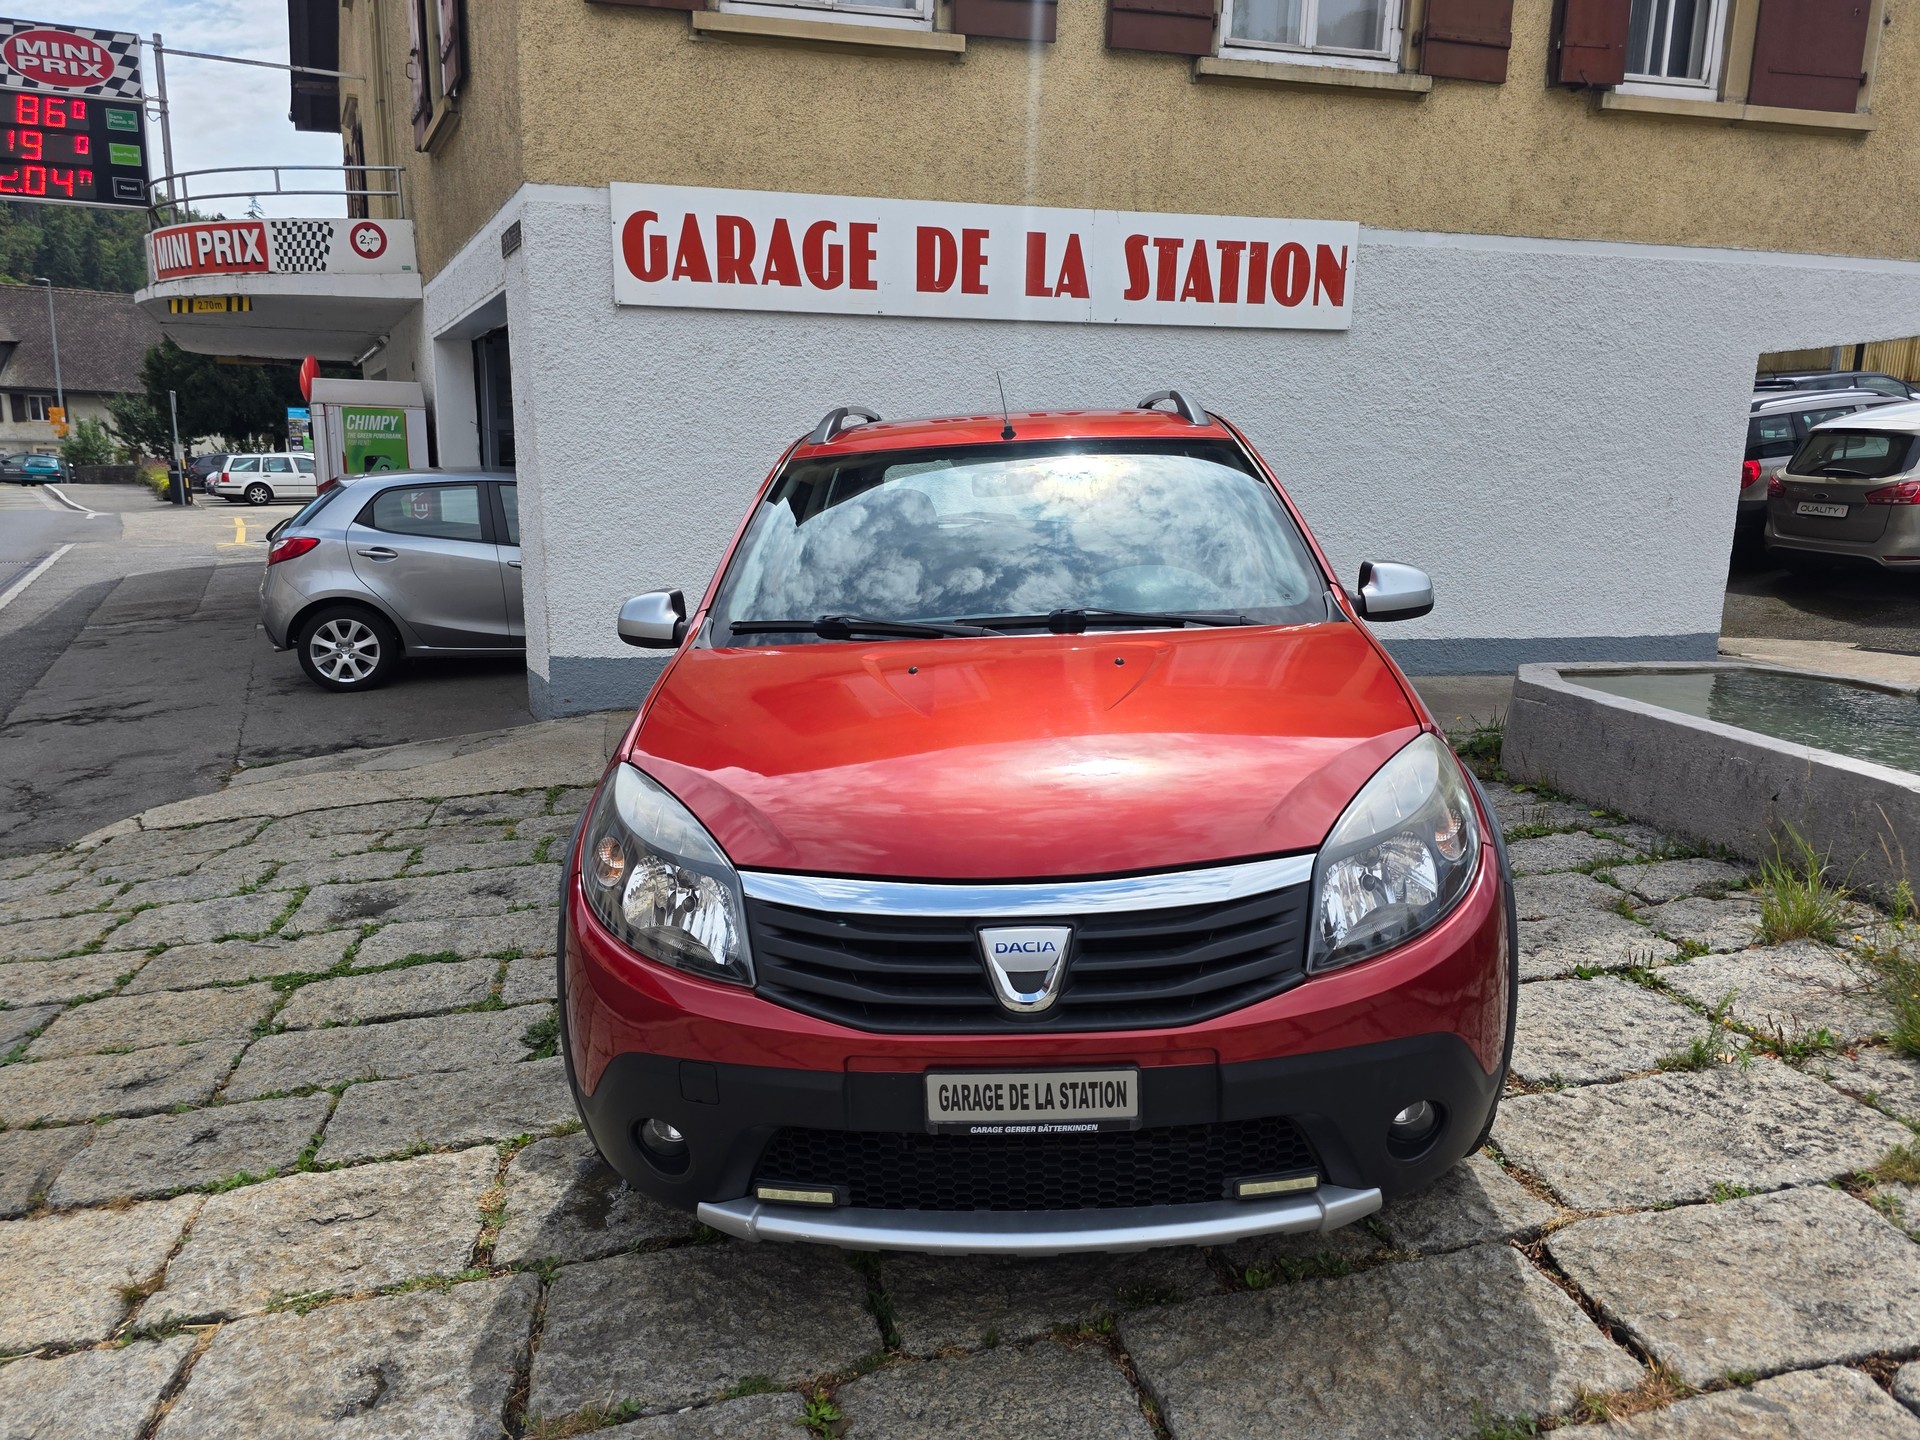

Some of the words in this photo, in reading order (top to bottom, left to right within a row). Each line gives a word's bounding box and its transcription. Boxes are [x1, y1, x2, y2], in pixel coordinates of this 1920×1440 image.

[15, 38, 102, 62] MINI
[17, 55, 104, 78] PRIX
[156, 232, 193, 271] MINI
[196, 228, 265, 265] PRIX
[622, 210, 878, 290] GARAGE
[916, 226, 990, 295] DE
[1025, 231, 1090, 299] LA
[1123, 233, 1349, 307] STATION
[346, 414, 399, 431] CHIMPY
[1800, 504, 1840, 515] QUALITY
[995, 941, 1056, 954] DACIA
[939, 1083, 1004, 1112] GARAGE
[1009, 1083, 1030, 1111] DE
[1034, 1082, 1055, 1110] LA
[1059, 1080, 1127, 1110] STATION
[1004, 1125, 1036, 1133] GERBER
[1037, 1123, 1099, 1133] BÄTTERKINDEN
